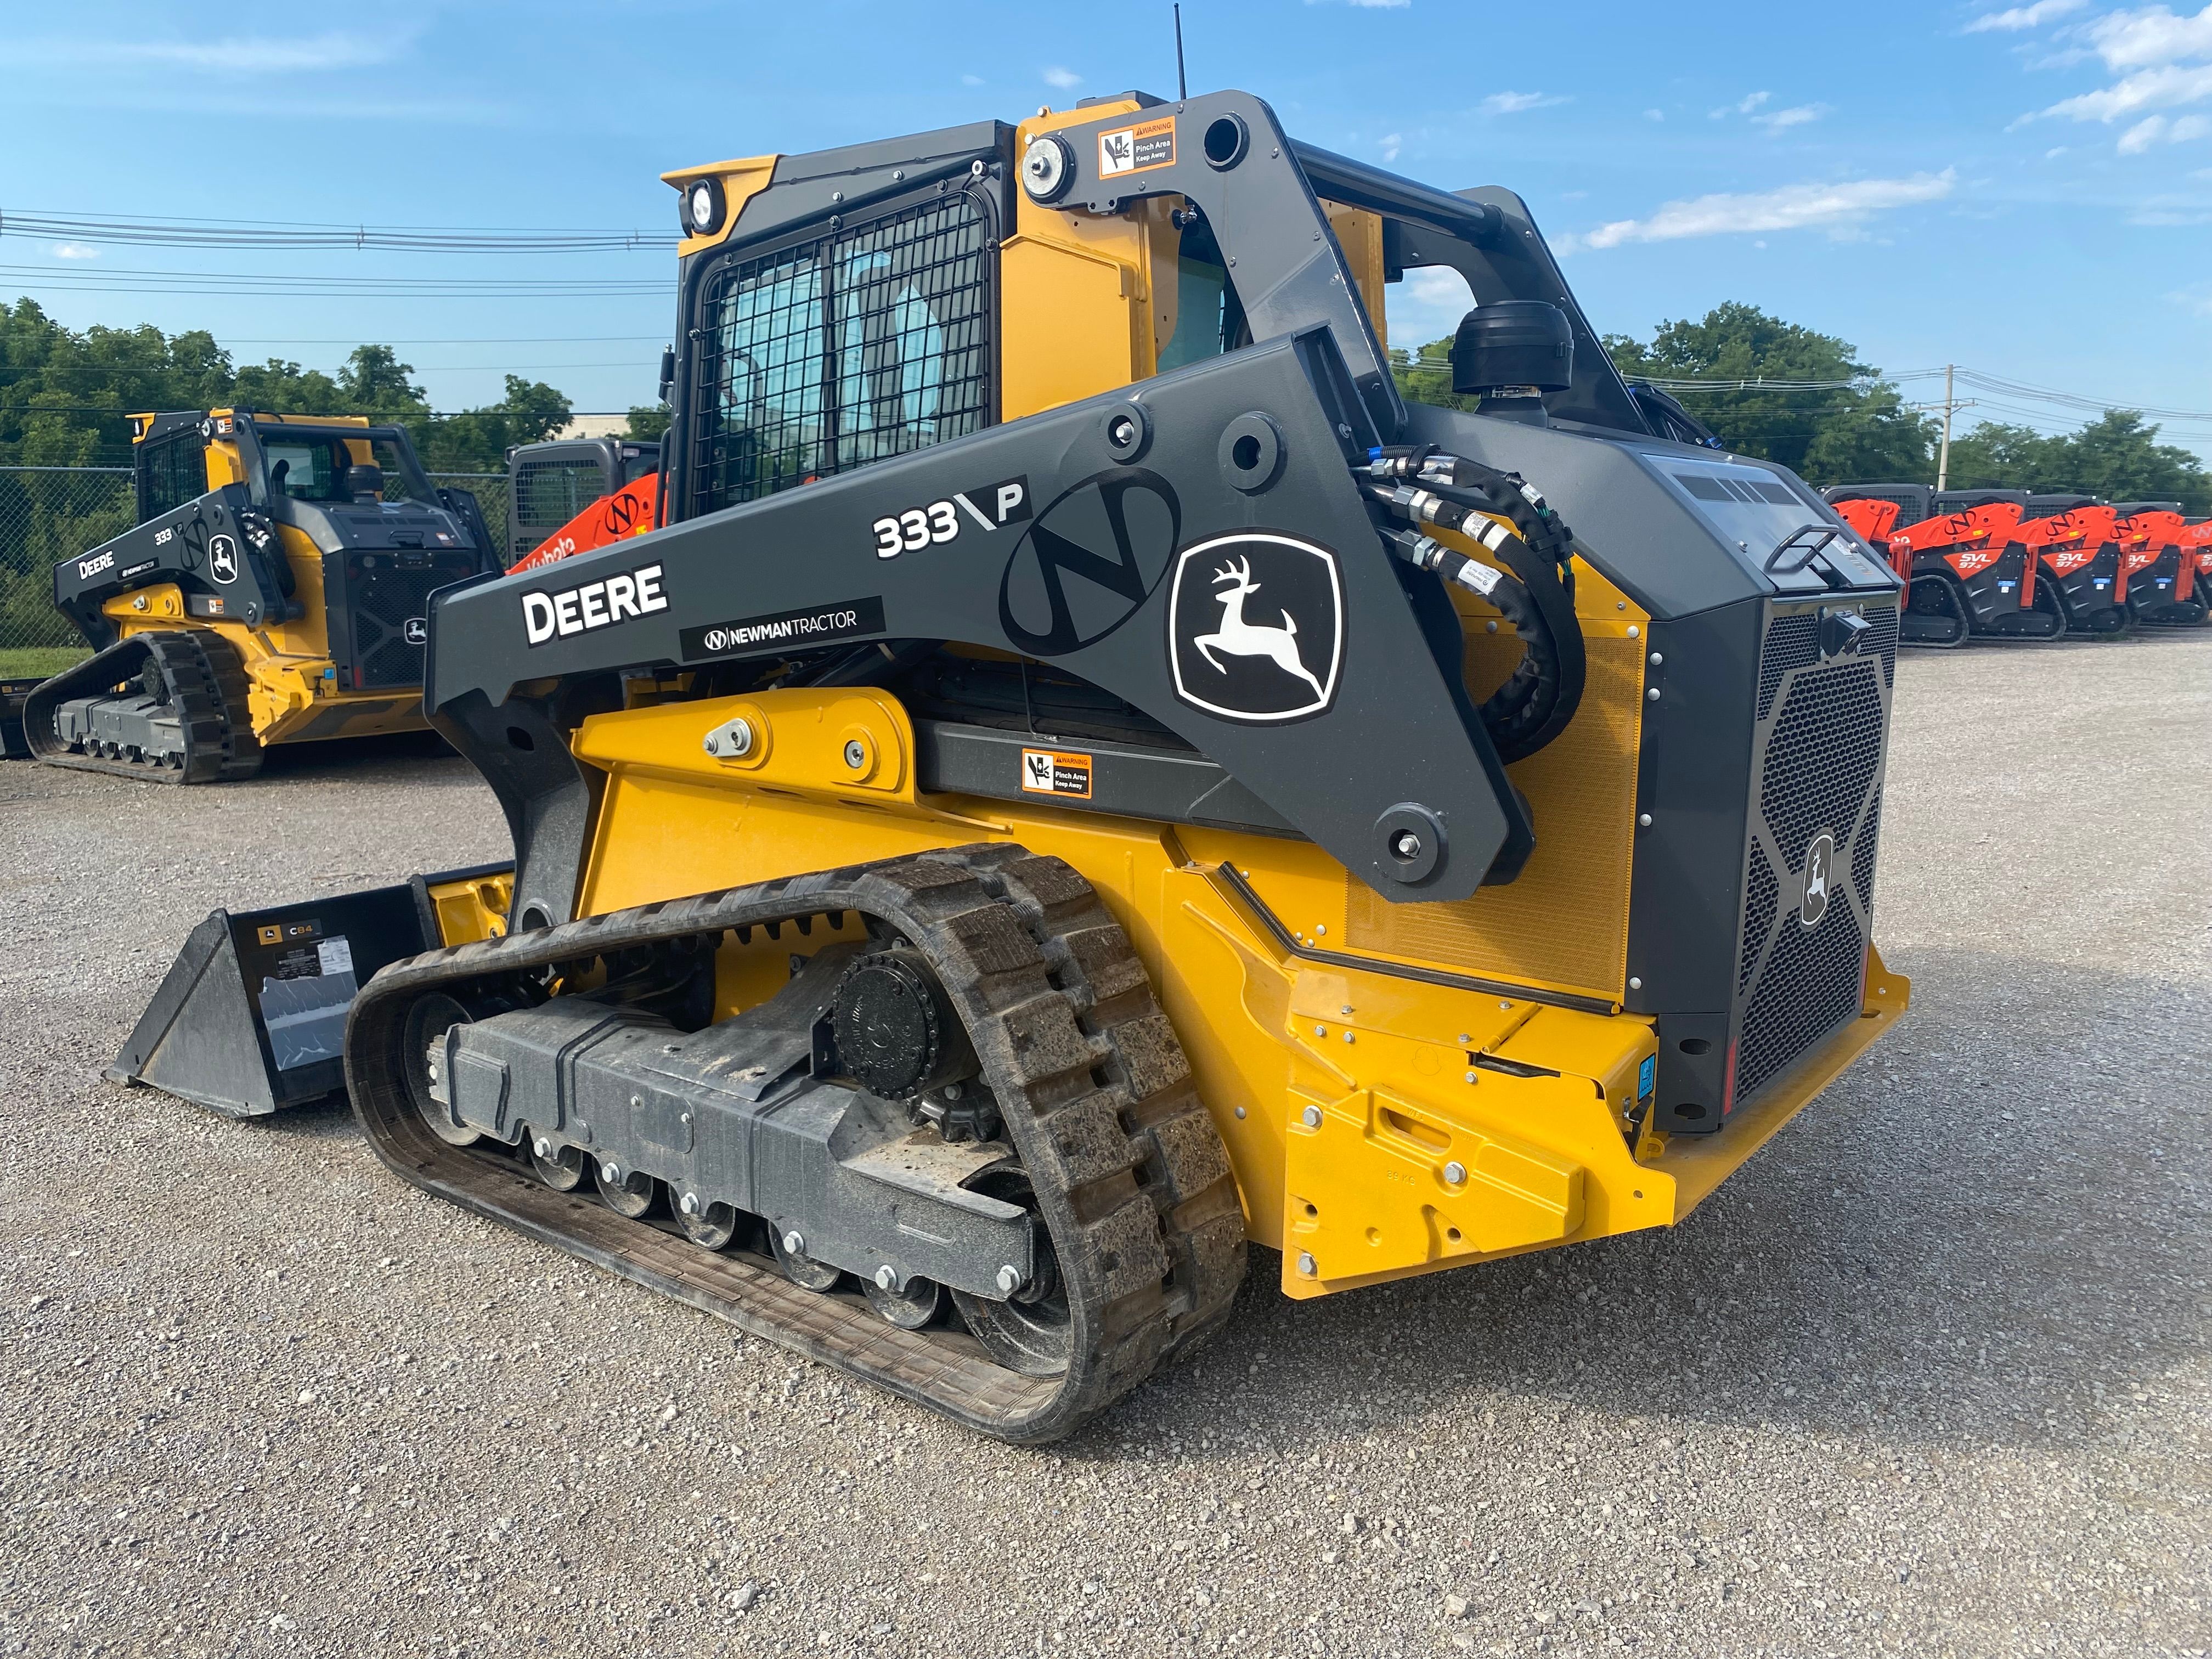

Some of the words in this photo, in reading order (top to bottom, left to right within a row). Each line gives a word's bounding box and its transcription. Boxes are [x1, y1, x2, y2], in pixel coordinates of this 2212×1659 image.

[1143, 122, 1171, 134] WARNING
[1136, 143, 1154, 153] Pinch
[1155, 140, 1171, 149] Area
[1959, 554, 1991, 562] SVL
[78, 551, 115, 580] DEERE
[522, 565, 669, 645] DEERE
[1062, 757, 1088, 765] WARNING
[1055, 771, 1072, 779] Pinch
[1073, 772, 1087, 781] Area
[1055, 780, 1068, 788] Keep
[1069, 781, 1082, 789] Away
[290, 924, 313, 935] C84
